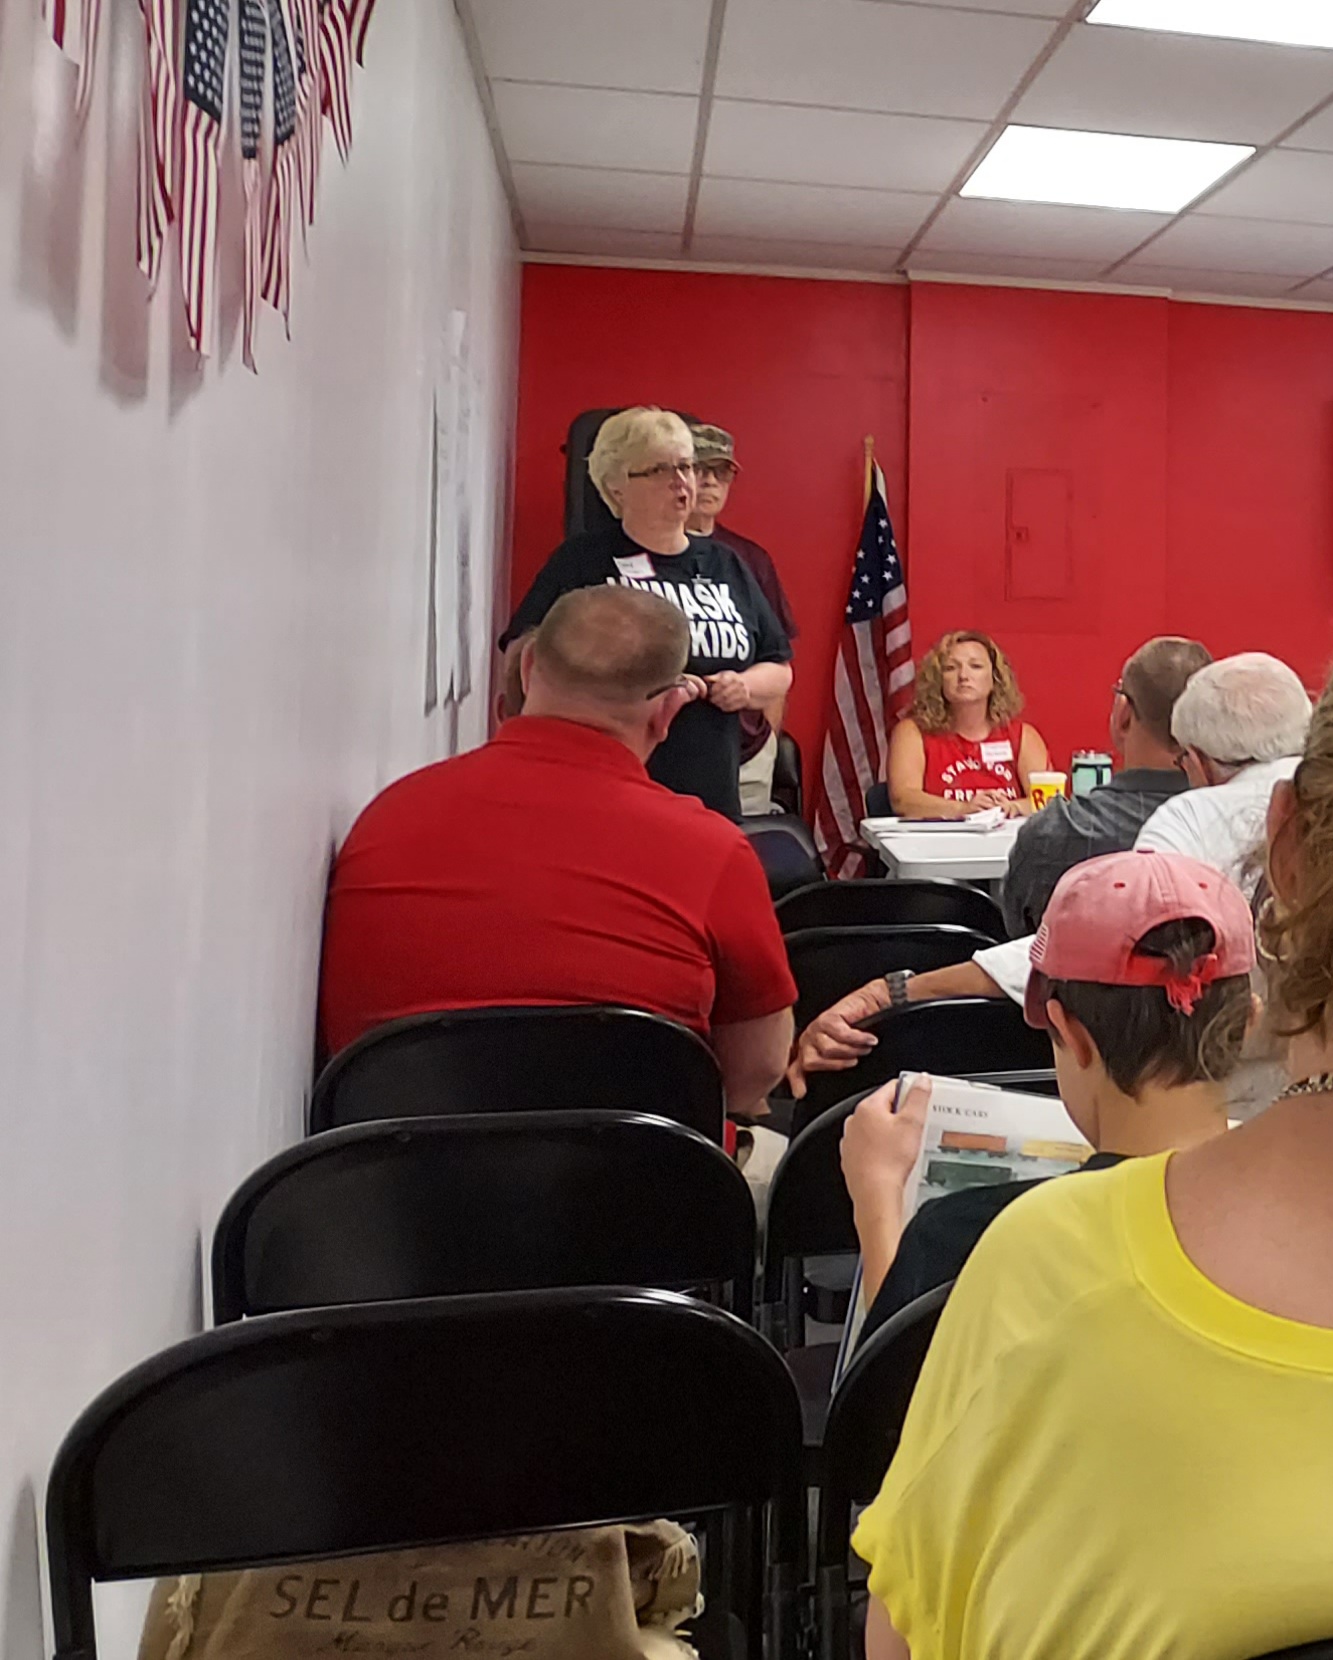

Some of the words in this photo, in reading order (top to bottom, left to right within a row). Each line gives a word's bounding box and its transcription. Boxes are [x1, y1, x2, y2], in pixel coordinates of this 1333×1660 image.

[606, 577, 744, 623] MASK
[690, 622, 750, 661] KIDS
[269, 1575, 371, 1622] SEL
[386, 1580, 449, 1623] de
[469, 1575, 597, 1620] MER
